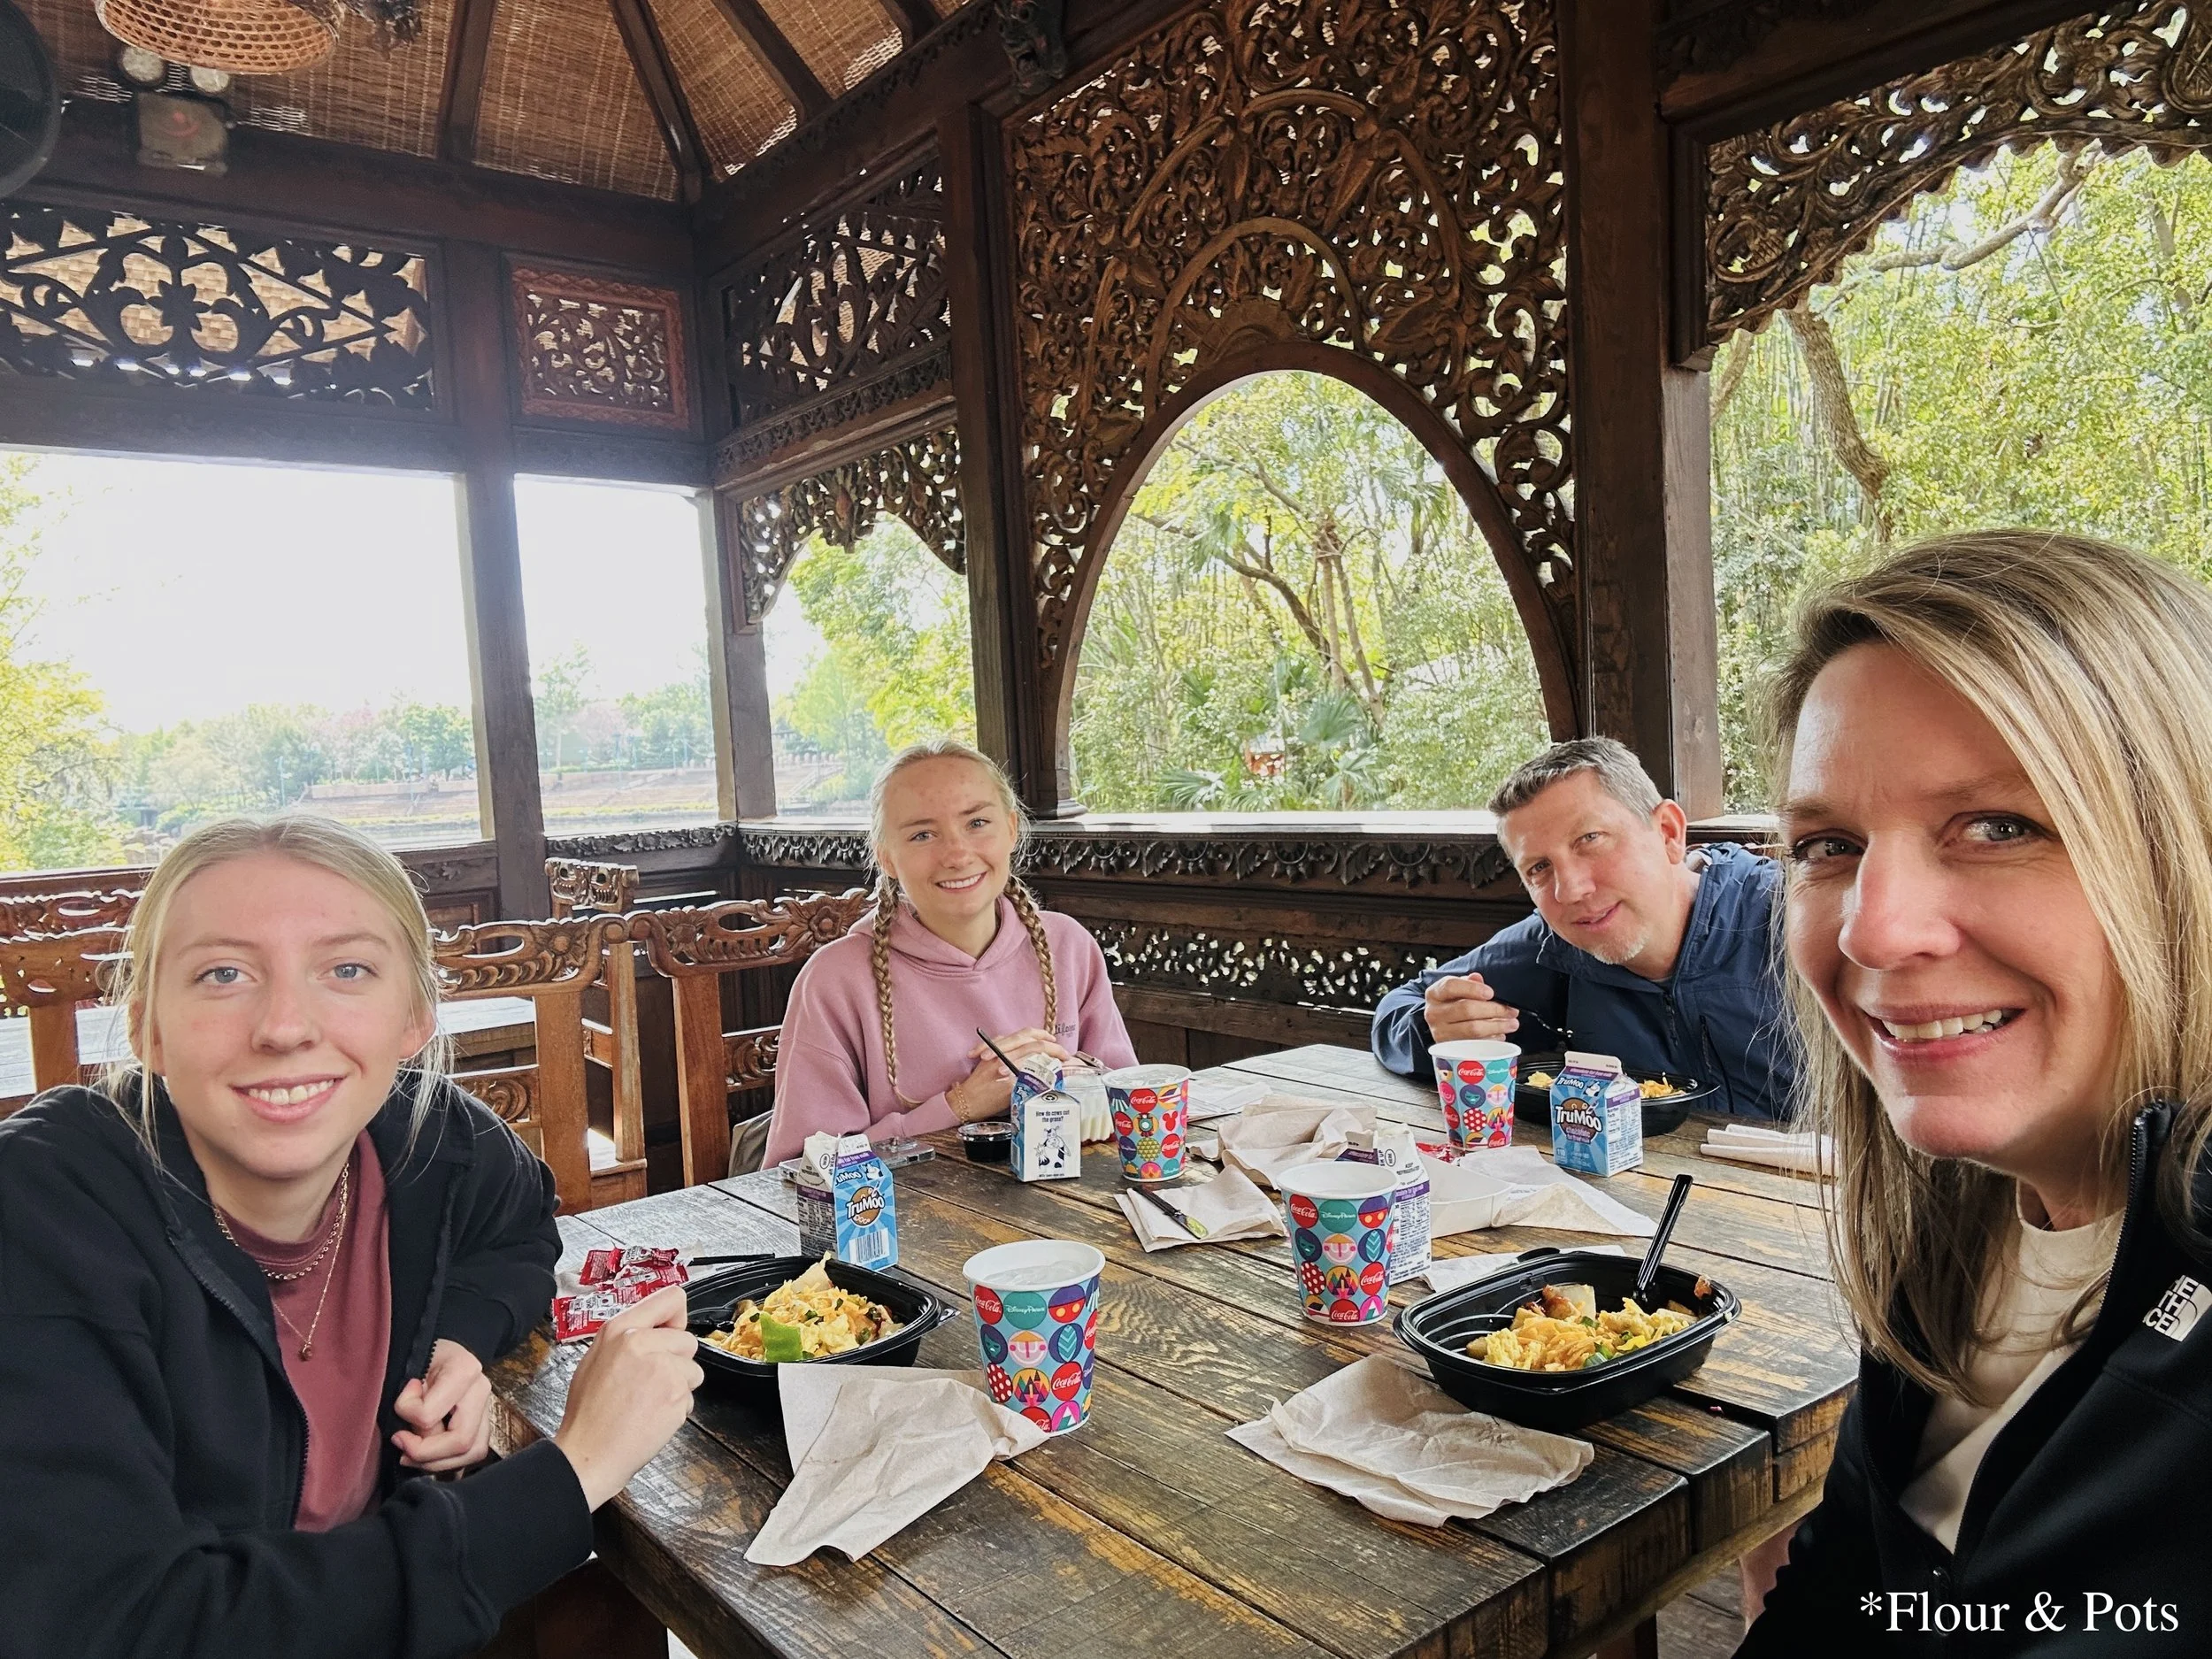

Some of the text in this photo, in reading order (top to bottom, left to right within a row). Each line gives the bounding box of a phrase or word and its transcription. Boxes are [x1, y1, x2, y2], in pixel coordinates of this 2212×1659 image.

[1556, 1077, 1584, 1089] TruMoo
[1555, 1106, 1602, 1132] TruMoo
[836, 1171, 862, 1183] uMoo
[847, 1196, 885, 1218] TruMoo
[1291, 1204, 1317, 1218] Coca-Cola
[1361, 1271, 1384, 1286] Coca-Cola
[976, 1295, 1002, 1314] Coca-Cola
[1332, 1310, 1358, 1320] Coca-Cola
[1053, 1371, 1081, 1390] Coca-Cola
